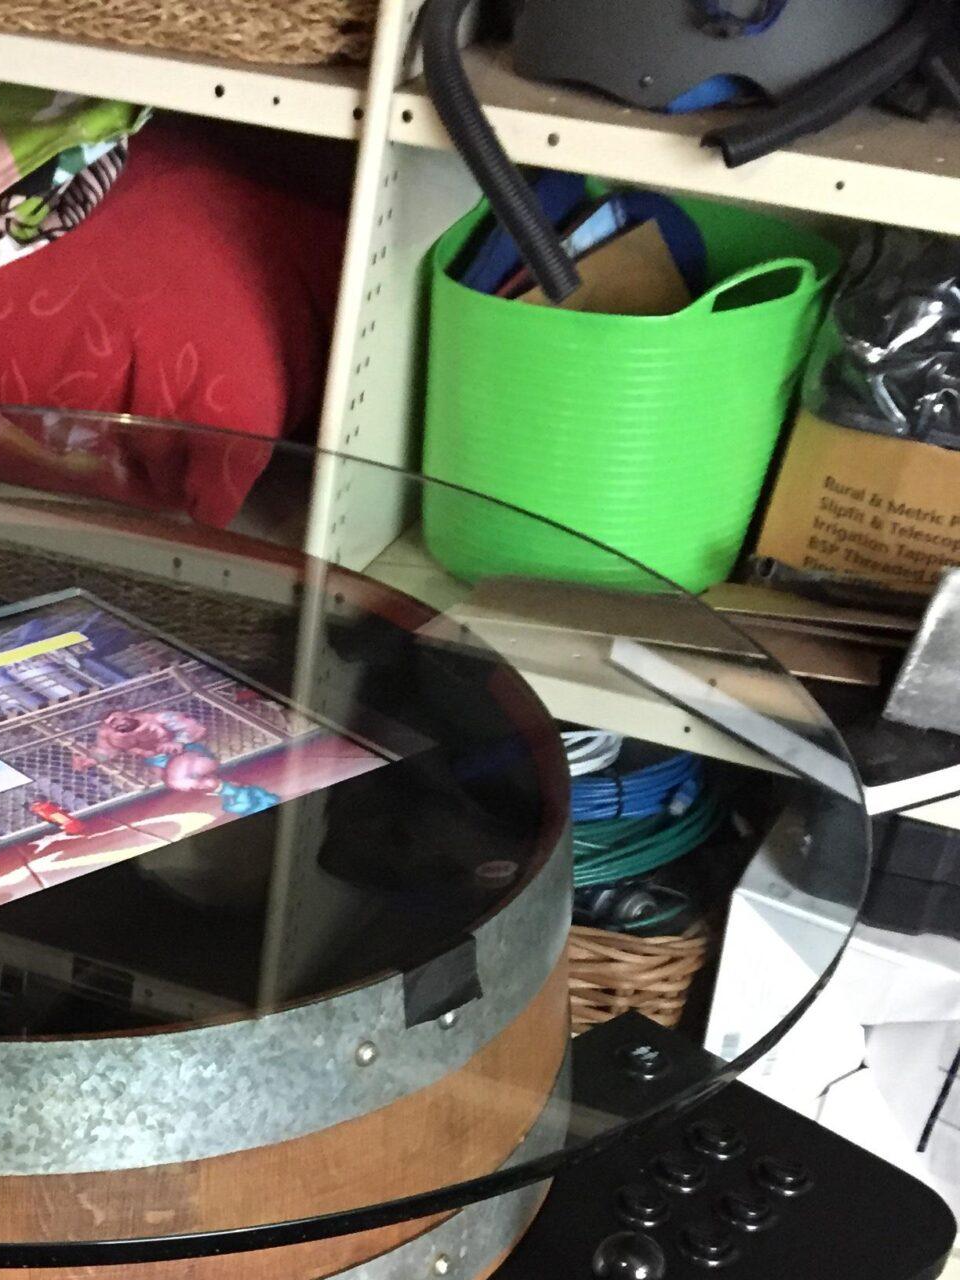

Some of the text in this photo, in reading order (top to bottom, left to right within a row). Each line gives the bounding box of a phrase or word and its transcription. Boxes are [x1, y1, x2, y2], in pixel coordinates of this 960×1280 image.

[824, 475, 866, 501] Rural
[869, 493, 882, 507] &
[888, 499, 944, 525] Metric
[813, 515, 889, 553] Irrigation
[870, 515, 884, 530] &
